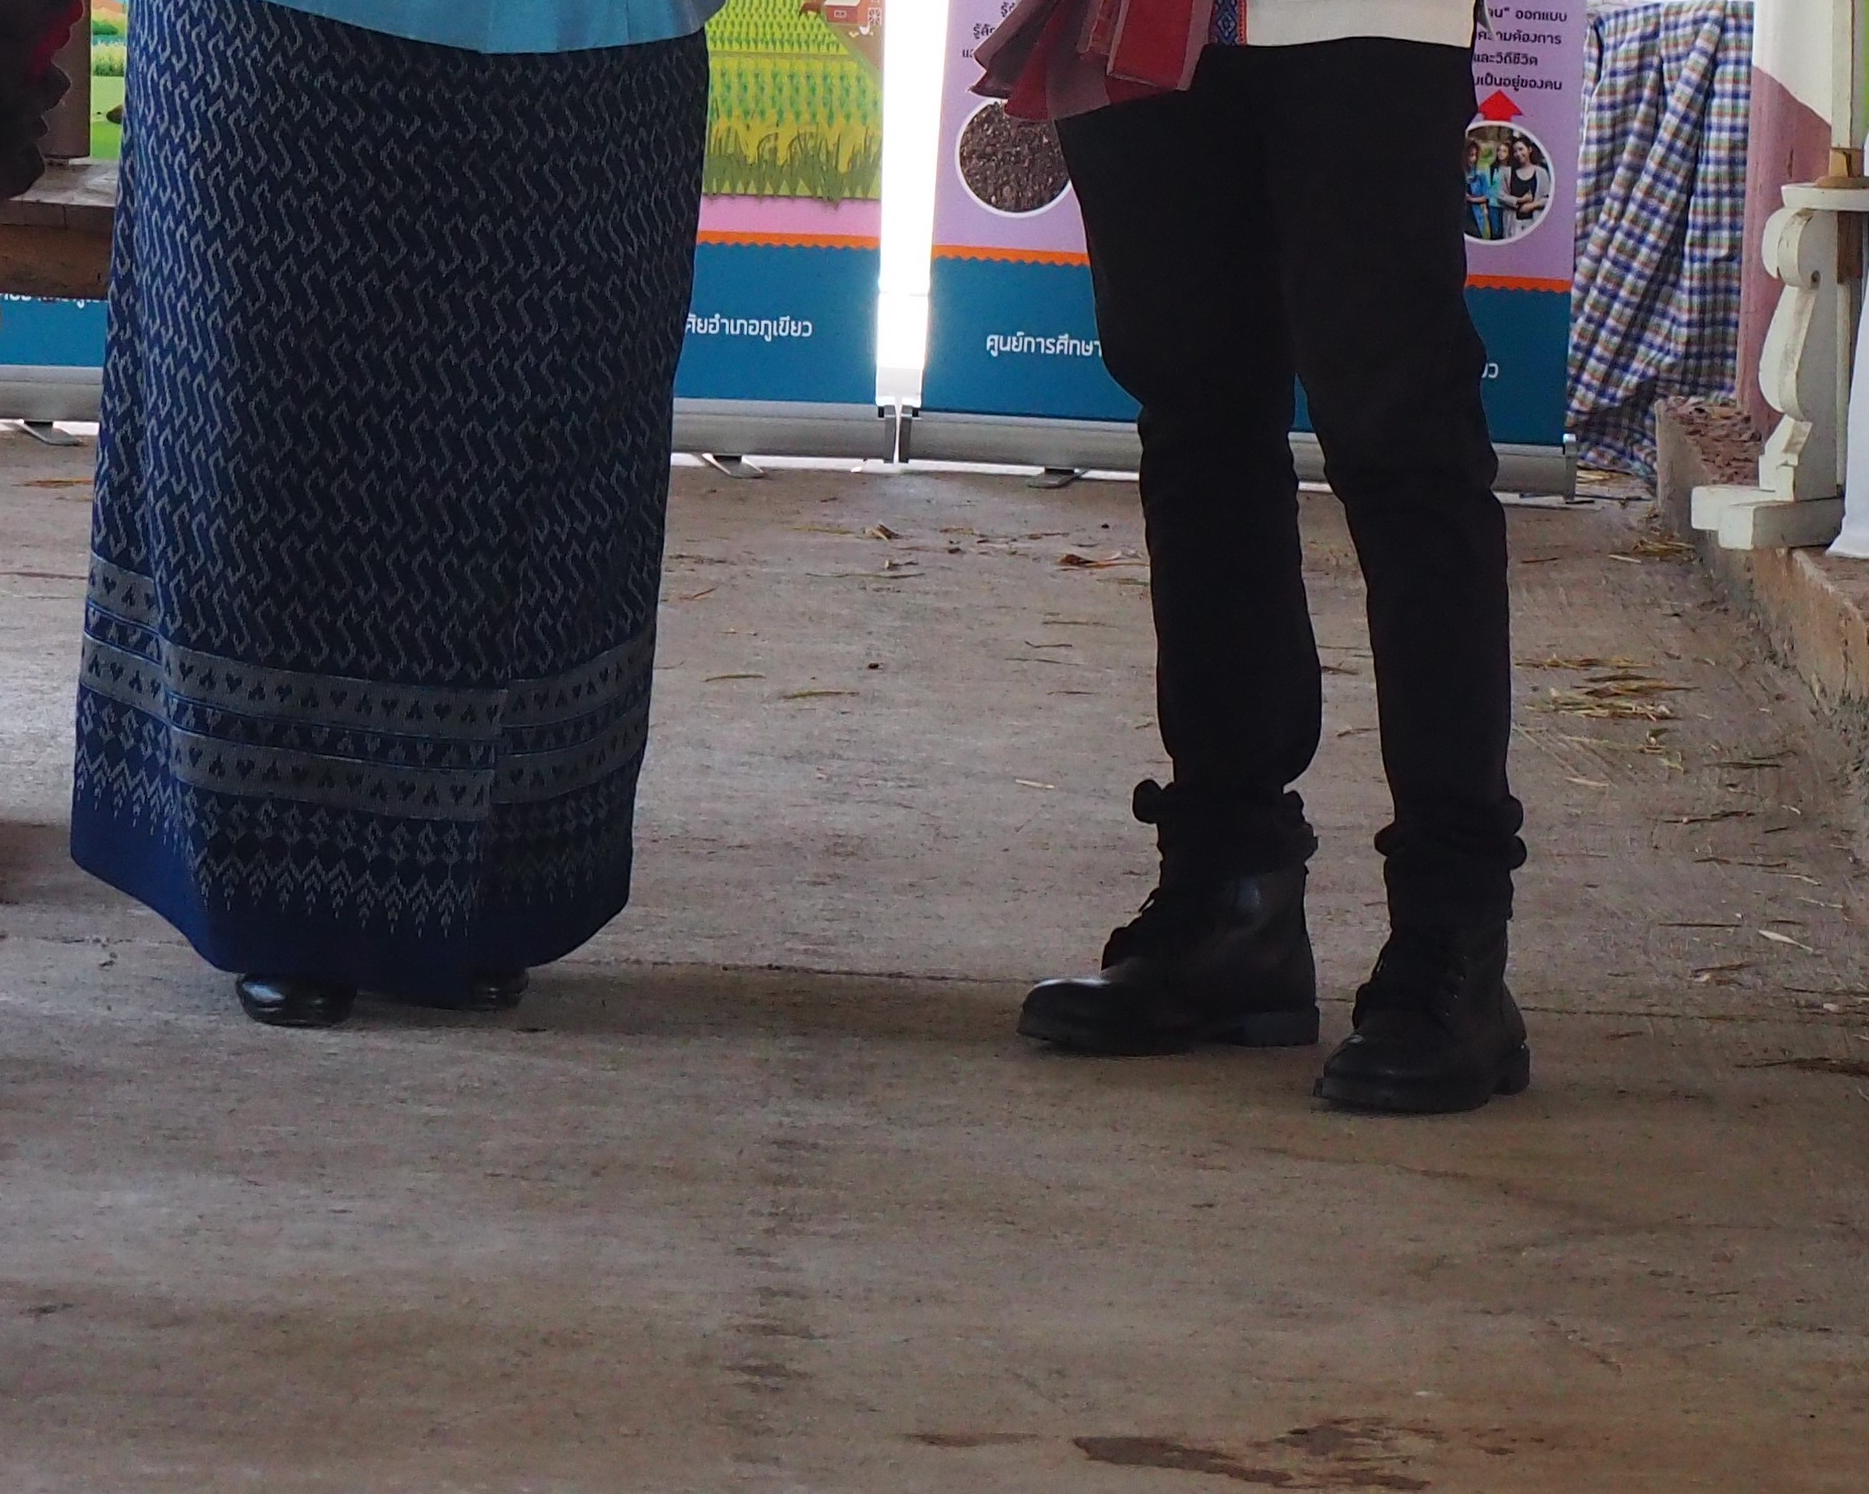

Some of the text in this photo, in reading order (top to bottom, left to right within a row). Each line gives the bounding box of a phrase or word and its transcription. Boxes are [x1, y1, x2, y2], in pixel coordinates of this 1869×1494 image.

[986, 331, 1103, 358] ศูนย์การศึกษา
